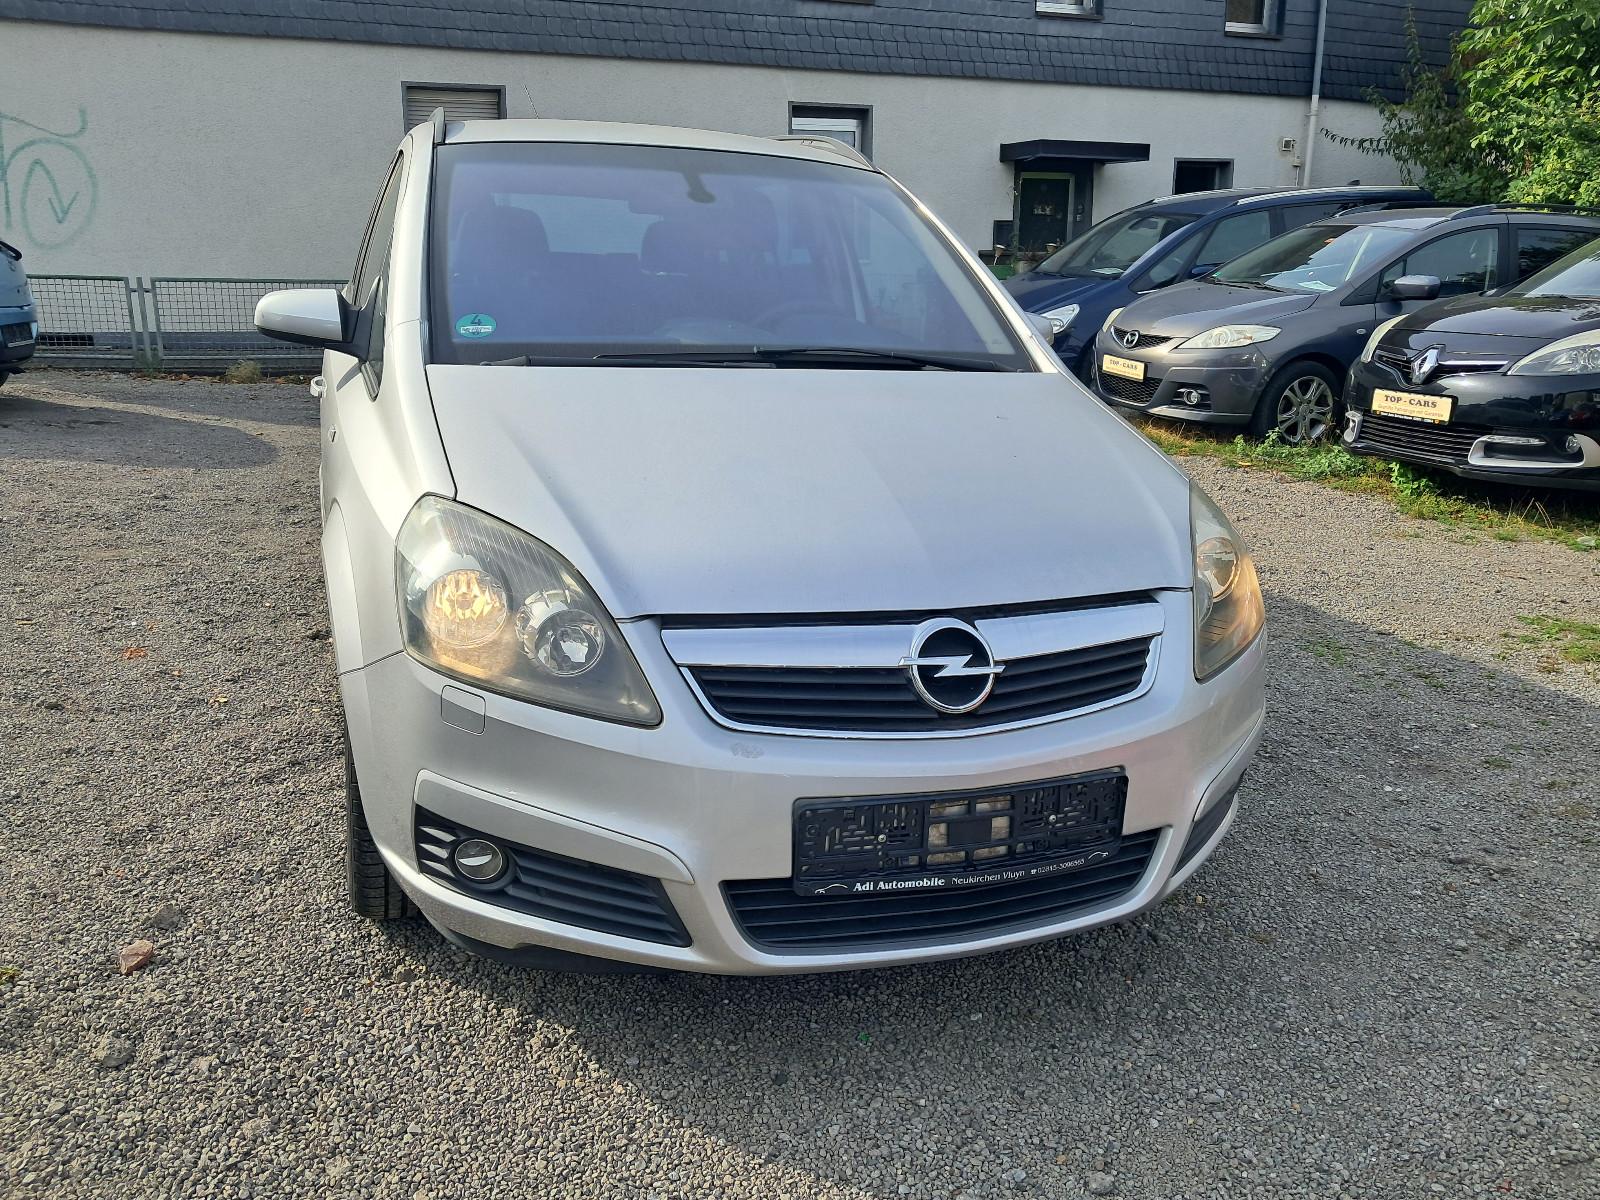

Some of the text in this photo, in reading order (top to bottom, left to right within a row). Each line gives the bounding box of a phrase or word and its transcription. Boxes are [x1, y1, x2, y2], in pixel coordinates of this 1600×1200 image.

[470, 314, 482, 326] 4
[1409, 398, 1437, 408] CARS
[853, 881, 874, 892] Adi
[877, 877, 946, 890] Automobile
[951, 873, 1000, 885] Neukirchen
[1003, 870, 1025, 881] Vluyn
